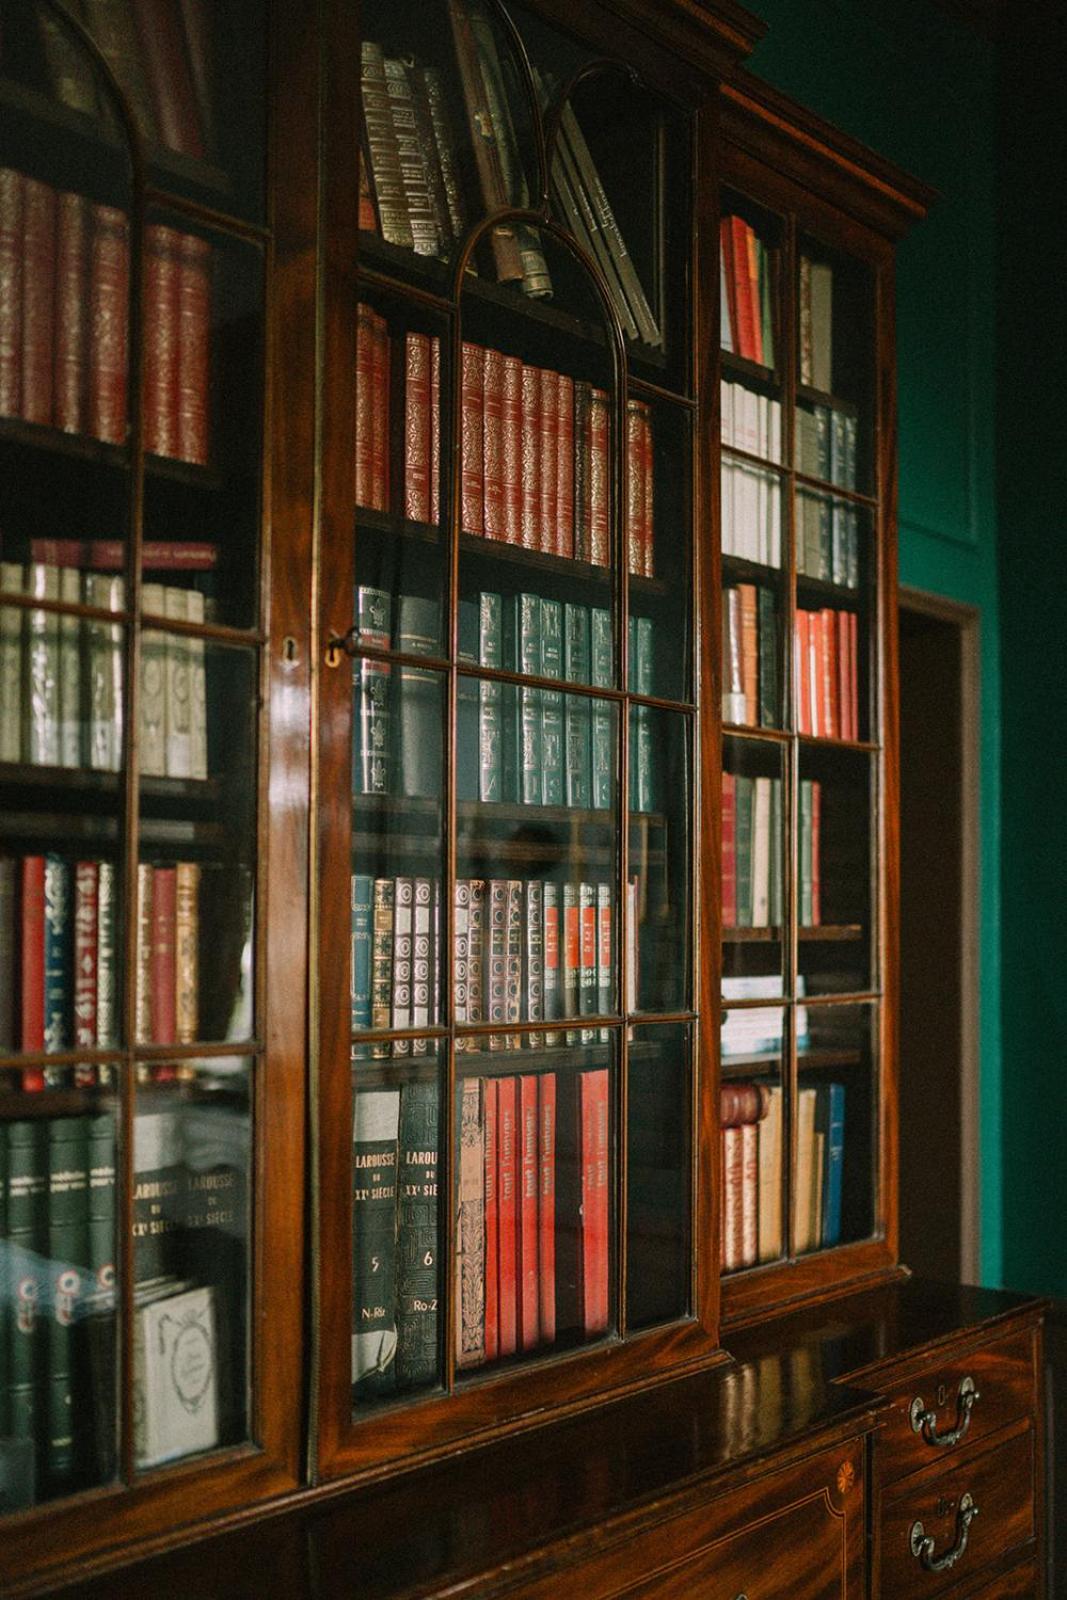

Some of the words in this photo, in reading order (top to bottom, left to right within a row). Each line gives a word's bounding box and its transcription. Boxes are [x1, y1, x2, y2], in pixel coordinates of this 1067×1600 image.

[355, 1152, 395, 1168] LAROUSSE
[371, 1256, 380, 1273] 5
[423, 1250, 433, 1266] 6
